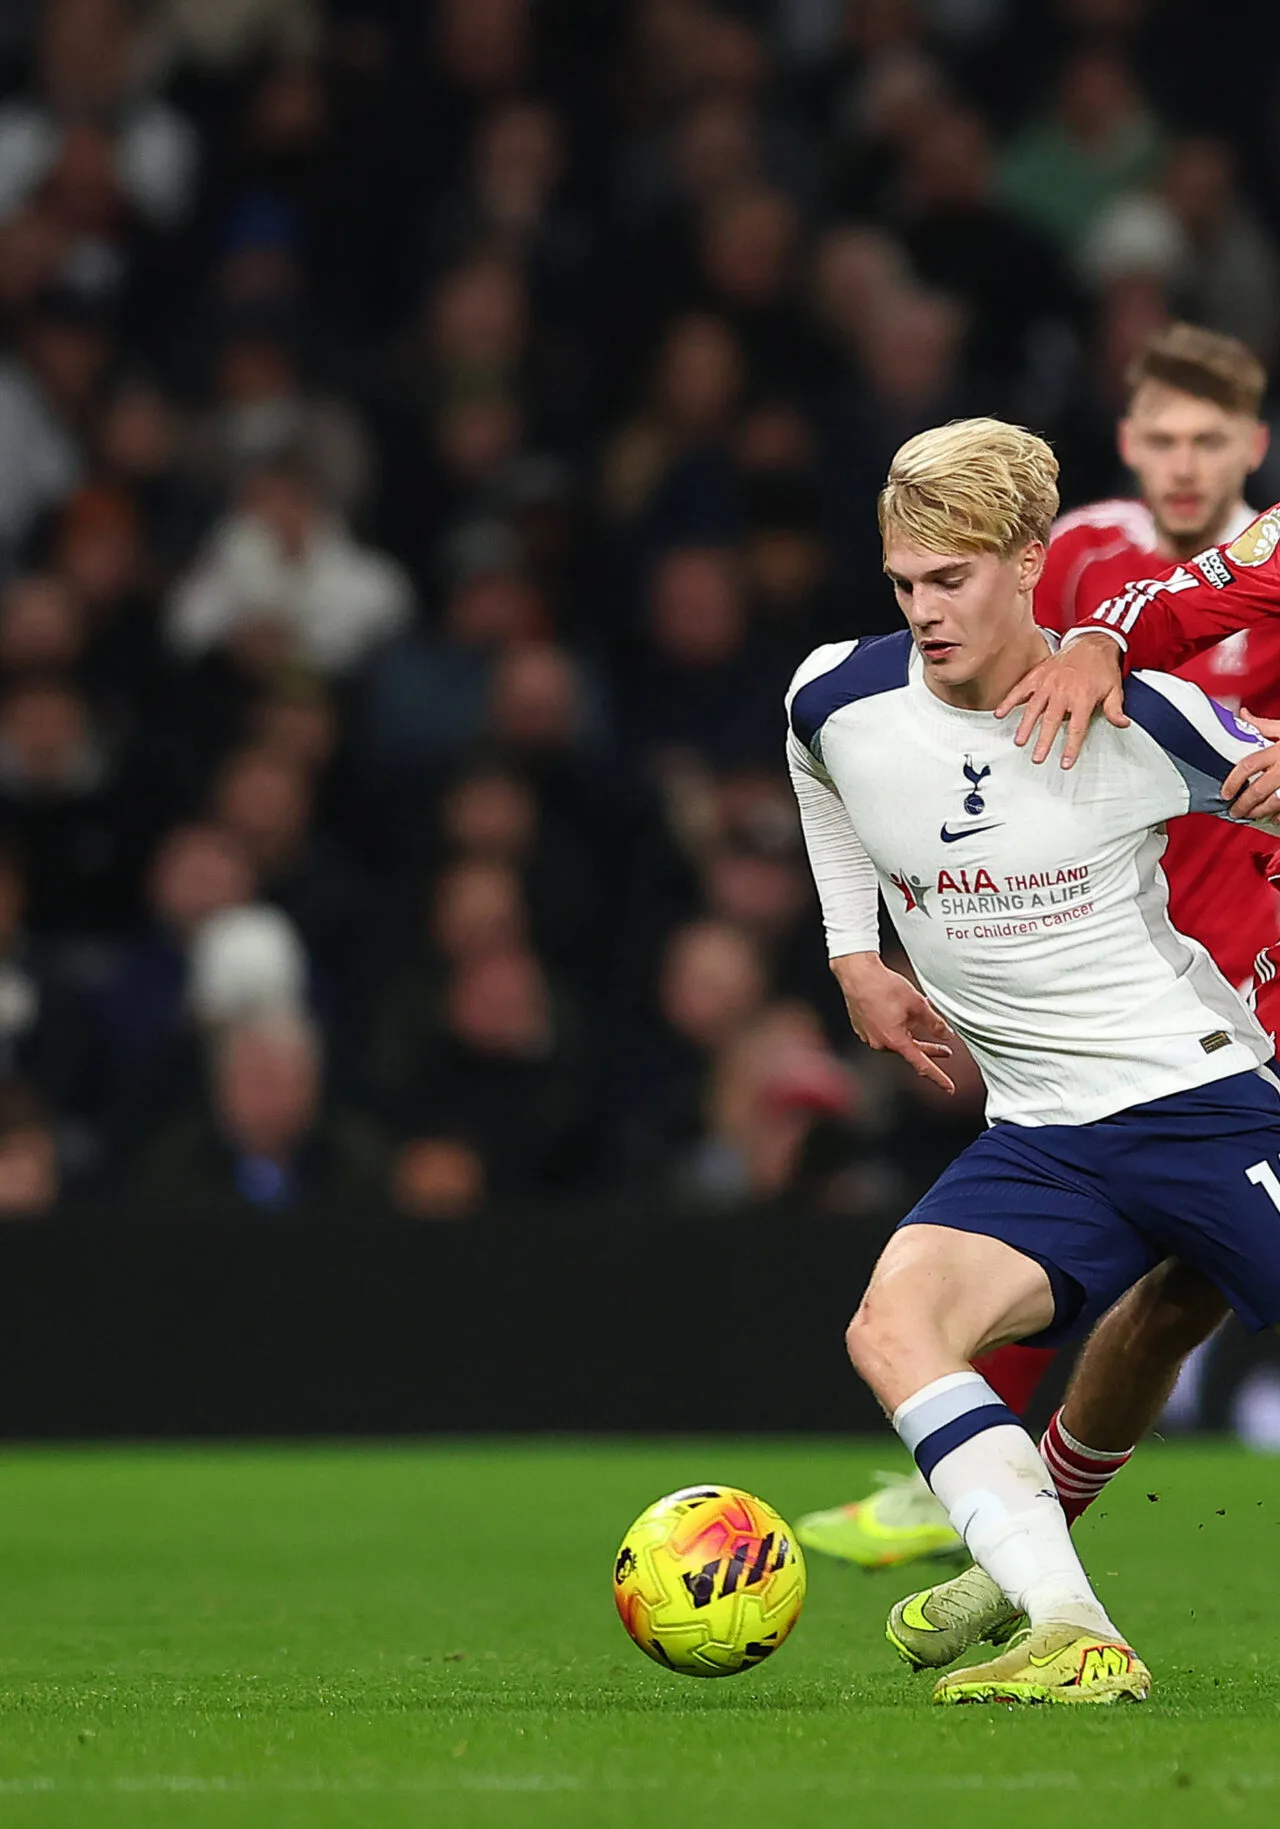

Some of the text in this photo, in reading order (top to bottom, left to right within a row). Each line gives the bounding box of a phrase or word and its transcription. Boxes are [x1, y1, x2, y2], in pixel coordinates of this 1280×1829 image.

[937, 866, 1089, 894] AIA THAILAND
[941, 881, 1091, 915] SHARING A LIFE
[946, 902, 1095, 940] For Children Cancer
